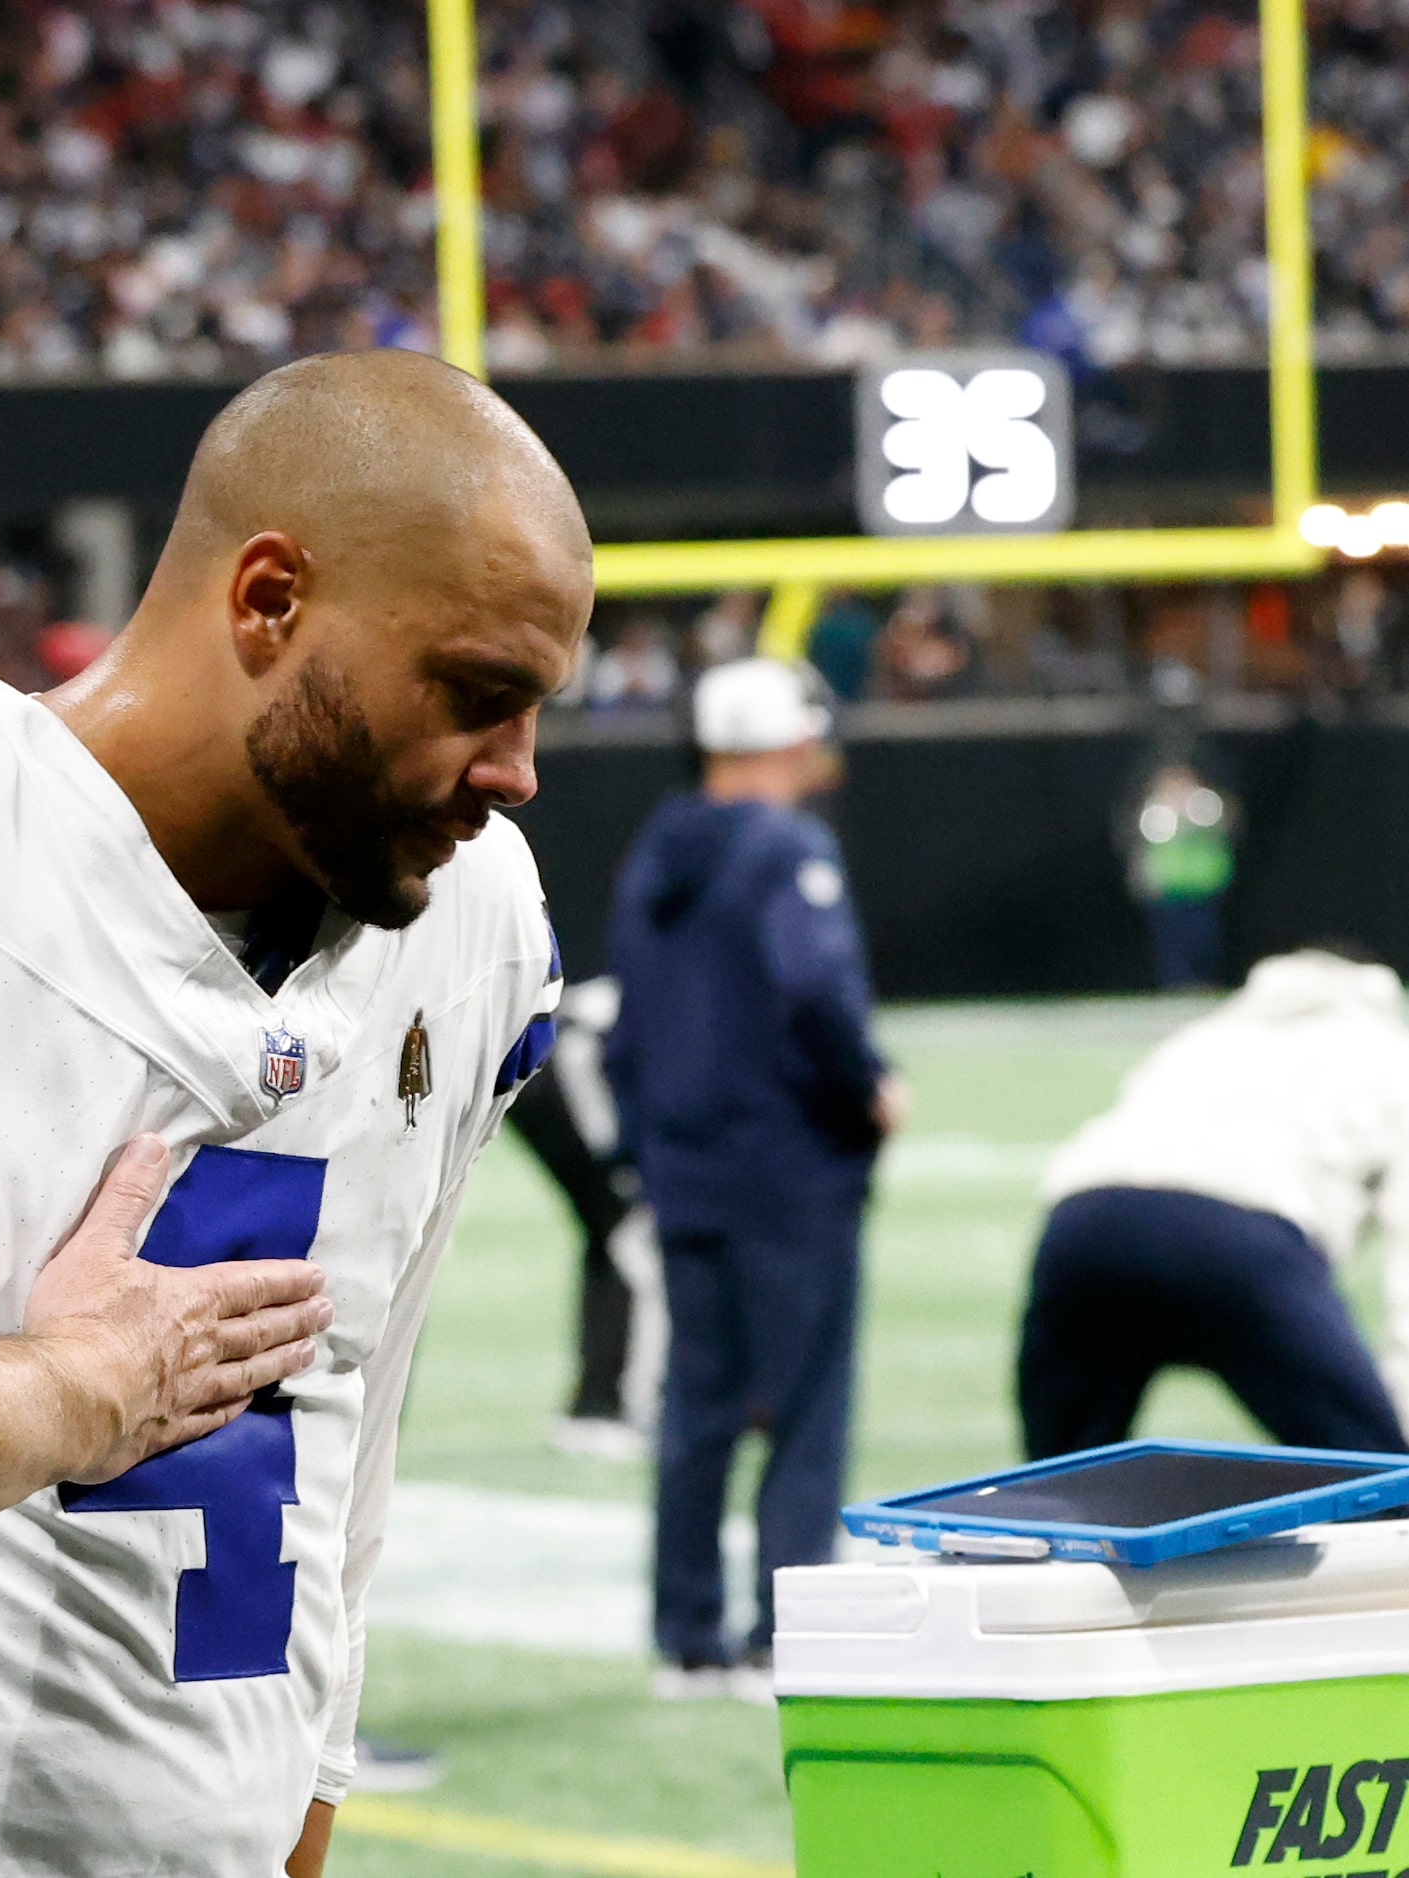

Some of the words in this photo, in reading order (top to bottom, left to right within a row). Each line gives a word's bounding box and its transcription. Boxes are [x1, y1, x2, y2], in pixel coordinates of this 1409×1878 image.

[268, 1056, 301, 1090] NFL
[57, 1144, 328, 1682] 4
[1230, 1757, 1409, 1867] FAST
